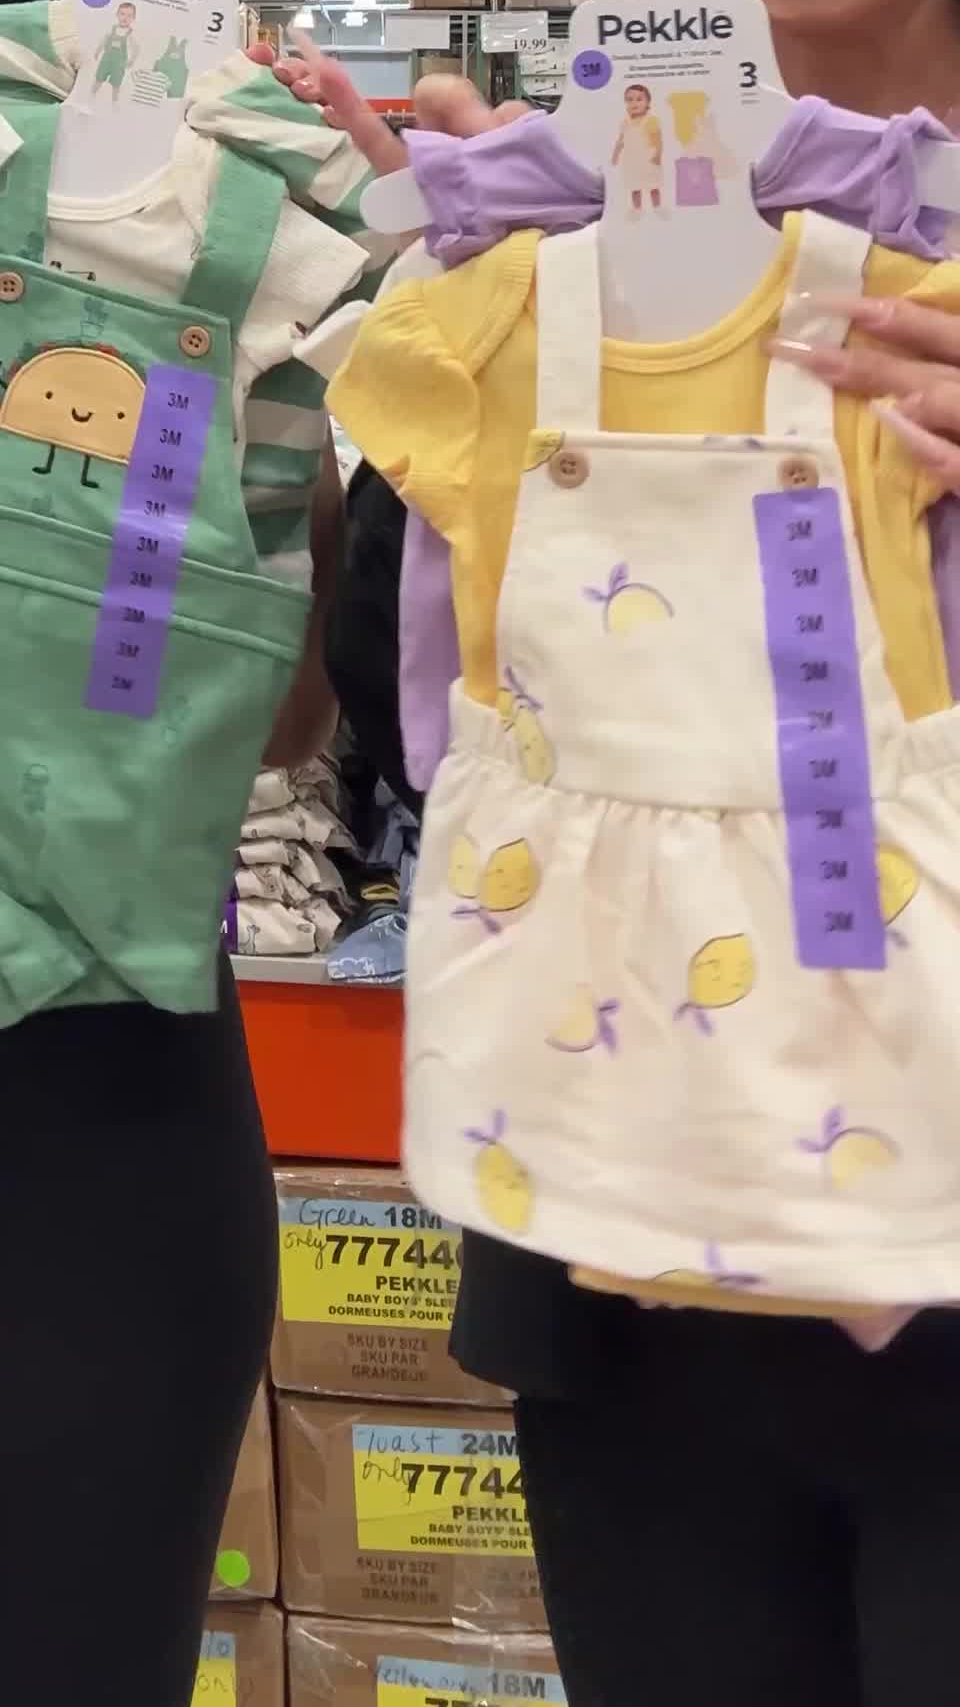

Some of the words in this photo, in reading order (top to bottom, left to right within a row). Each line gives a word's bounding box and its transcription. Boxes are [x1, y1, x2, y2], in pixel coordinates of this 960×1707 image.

[207, 12, 224, 33] 3
[597, 7, 733, 45] Pekkle
[739, 61, 757, 88] 3
[167, 393, 189, 410] 3M
[159, 429, 181, 446] 3M
[151, 465, 173, 482] 3M
[144, 501, 166, 517] 3M
[136, 536, 158, 554] 3M
[299, 1198, 375, 1229] Green
[376, 1275, 457, 1294] PEKKLE
[347, 1293, 380, 1304] BABY
[328, 1306, 404, 1319] DORMEUSES
[409, 1310, 443, 1321] POUR
[429, 1523, 462, 1534] BABY
